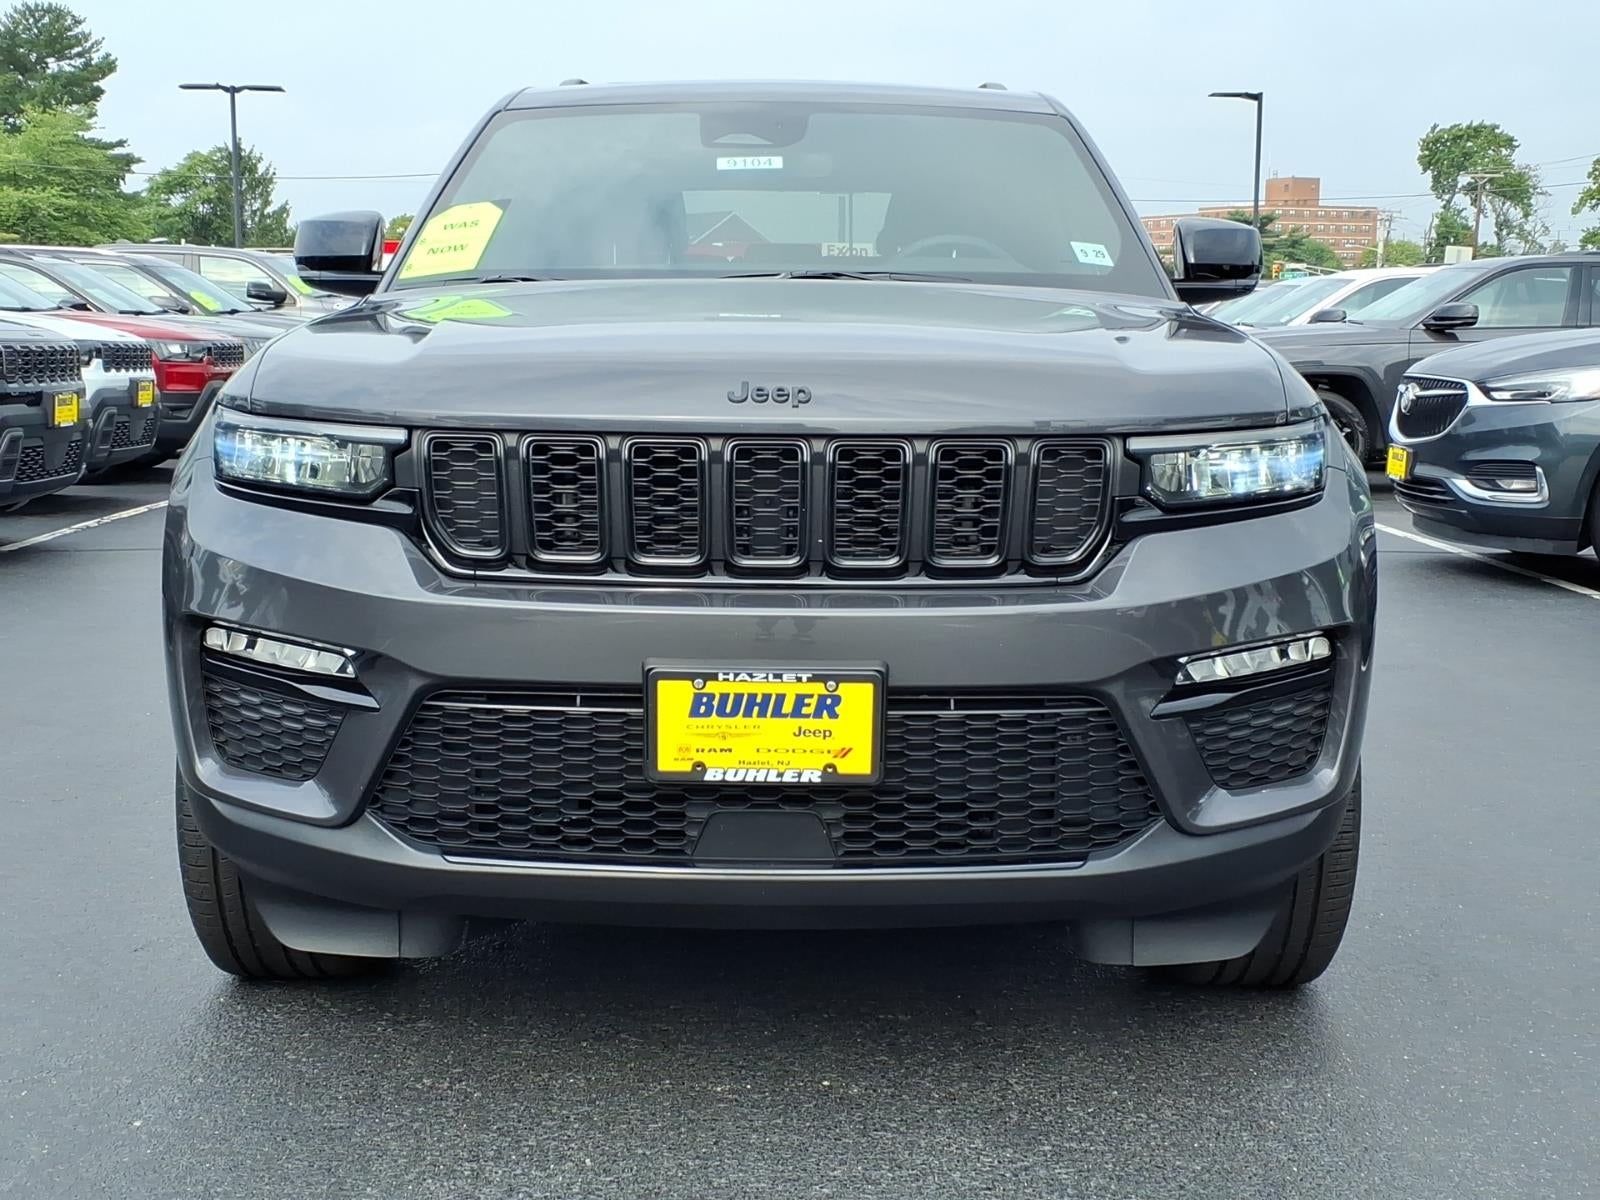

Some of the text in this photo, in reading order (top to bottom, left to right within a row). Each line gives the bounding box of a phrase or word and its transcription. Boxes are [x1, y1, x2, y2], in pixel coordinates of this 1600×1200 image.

[727, 158, 773, 168] 9104
[443, 219, 480, 231] WAS
[426, 243, 468, 256] NOW
[726, 381, 812, 408] Jeep
[717, 672, 813, 683] HAZLET
[688, 691, 842, 720] BUHLER
[792, 726, 833, 740] Jeep
[703, 767, 822, 783] BUHLER
